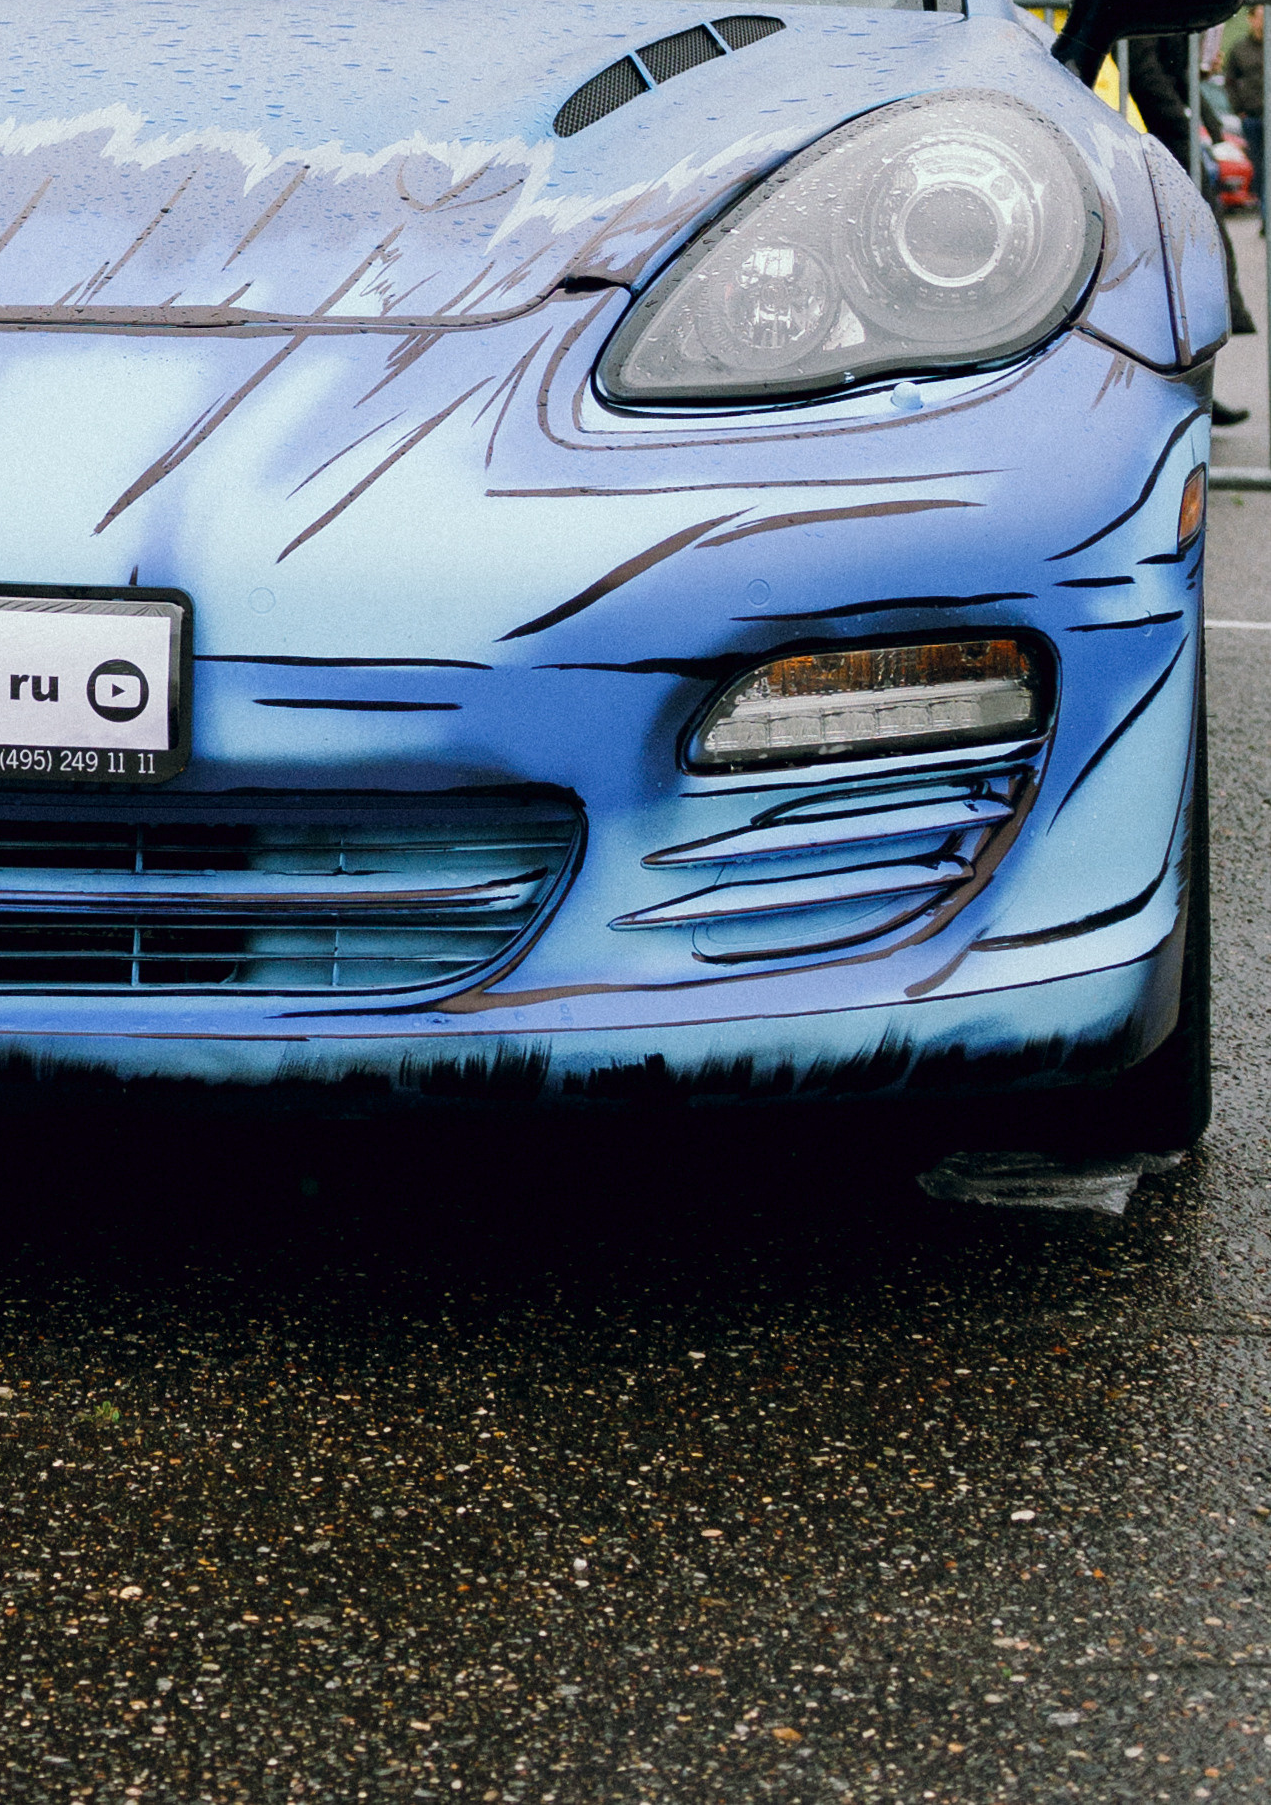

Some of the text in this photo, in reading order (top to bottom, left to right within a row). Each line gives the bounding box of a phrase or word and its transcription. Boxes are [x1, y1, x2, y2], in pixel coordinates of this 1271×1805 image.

[9, 673, 59, 703] ru
[0, 748, 53, 772] (495)
[59, 749, 99, 773] 249
[107, 751, 126, 774] 11
[136, 752, 156, 775] 11
